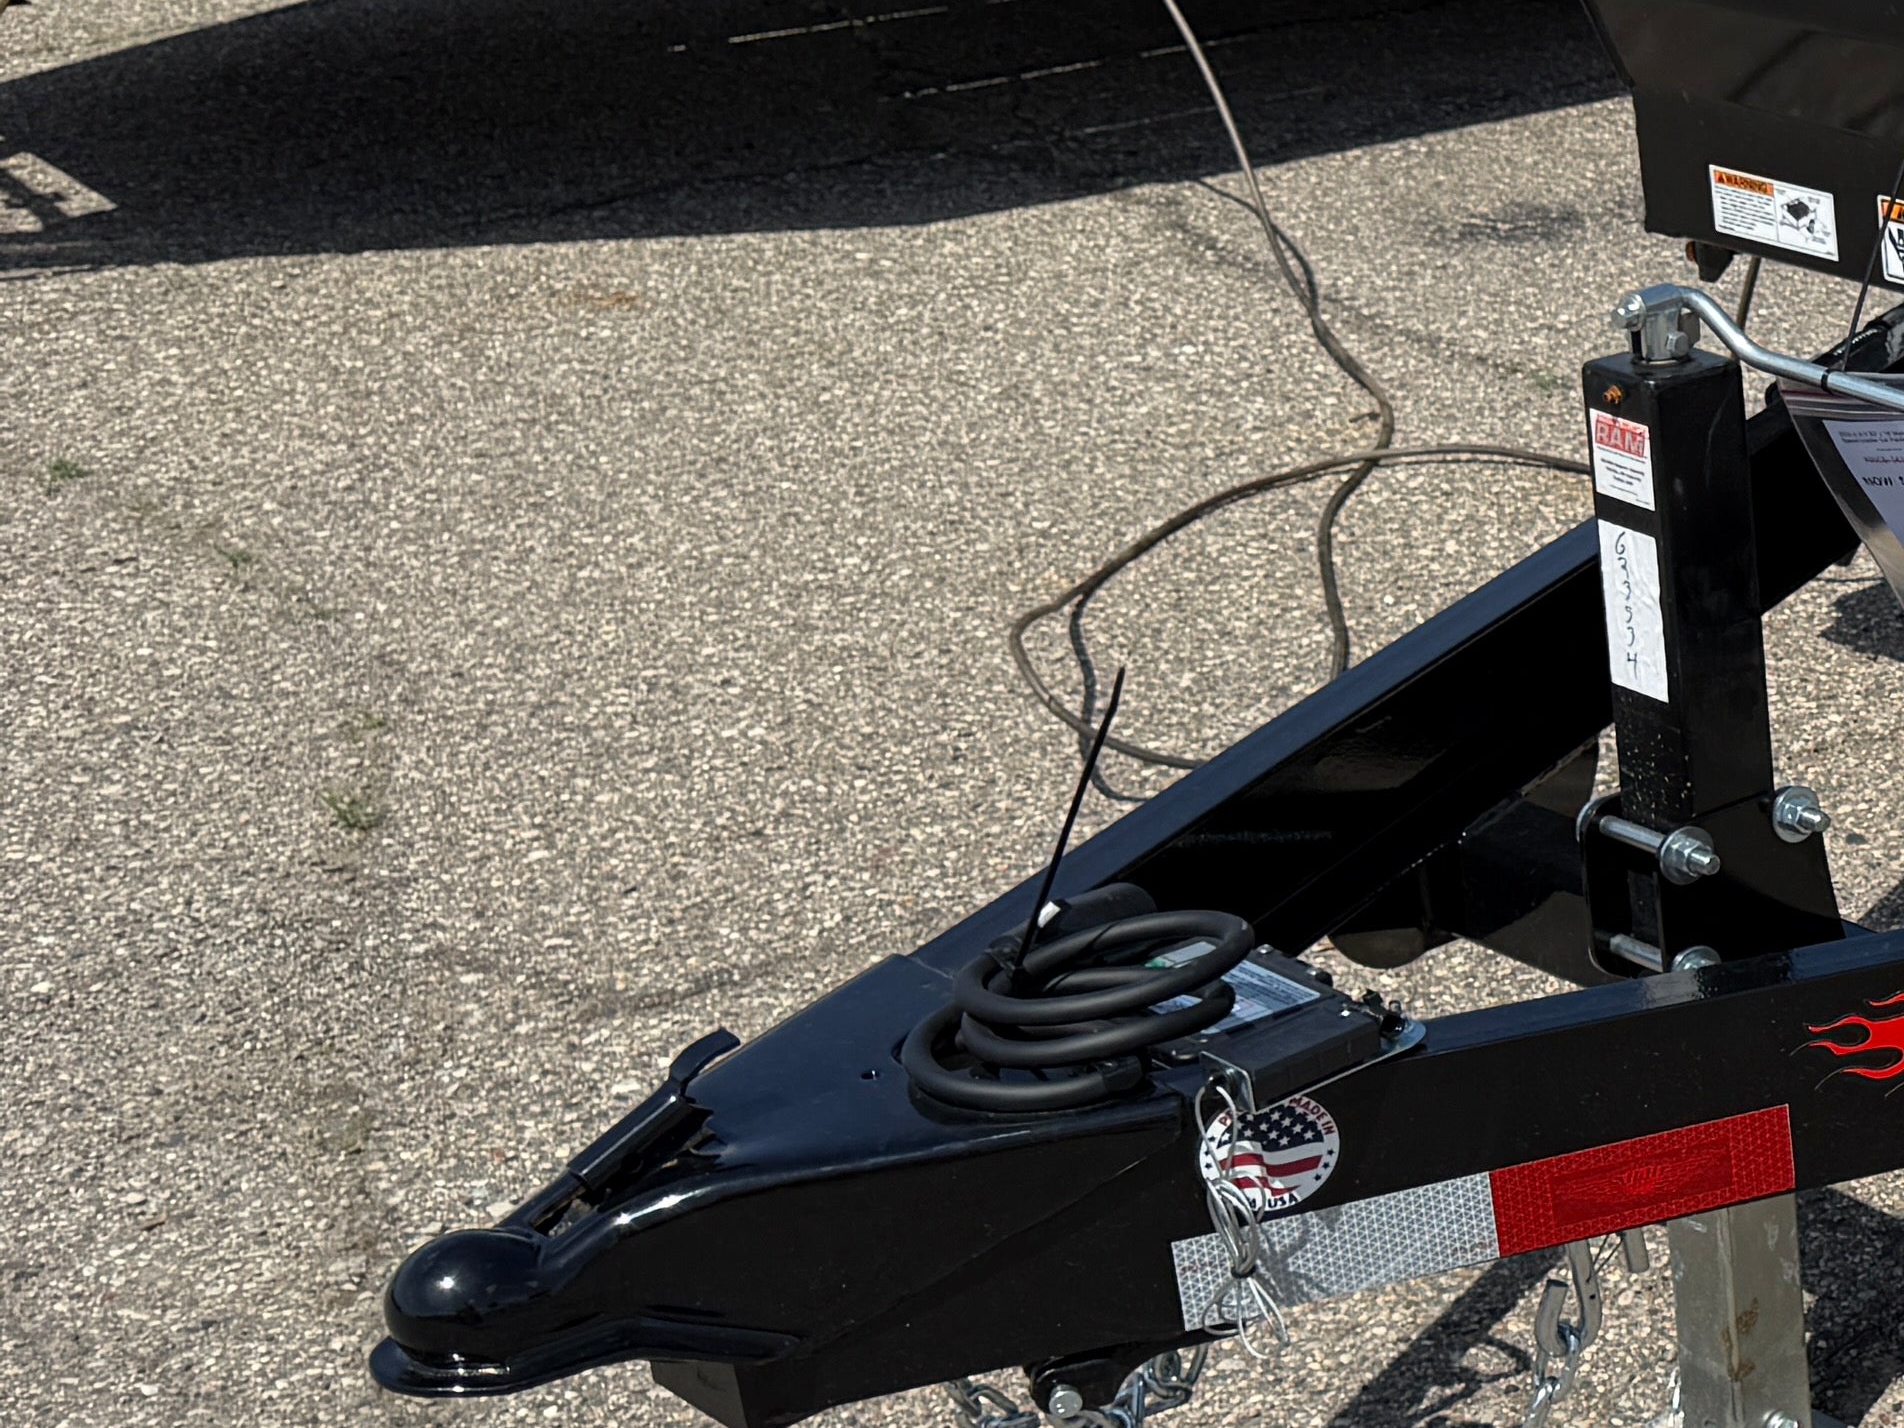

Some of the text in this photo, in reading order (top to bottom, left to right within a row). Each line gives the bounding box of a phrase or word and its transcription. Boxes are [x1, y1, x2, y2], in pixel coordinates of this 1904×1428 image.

[1289, 1096, 1336, 1135] MADE IN
[1268, 1192, 1298, 1209] USA
